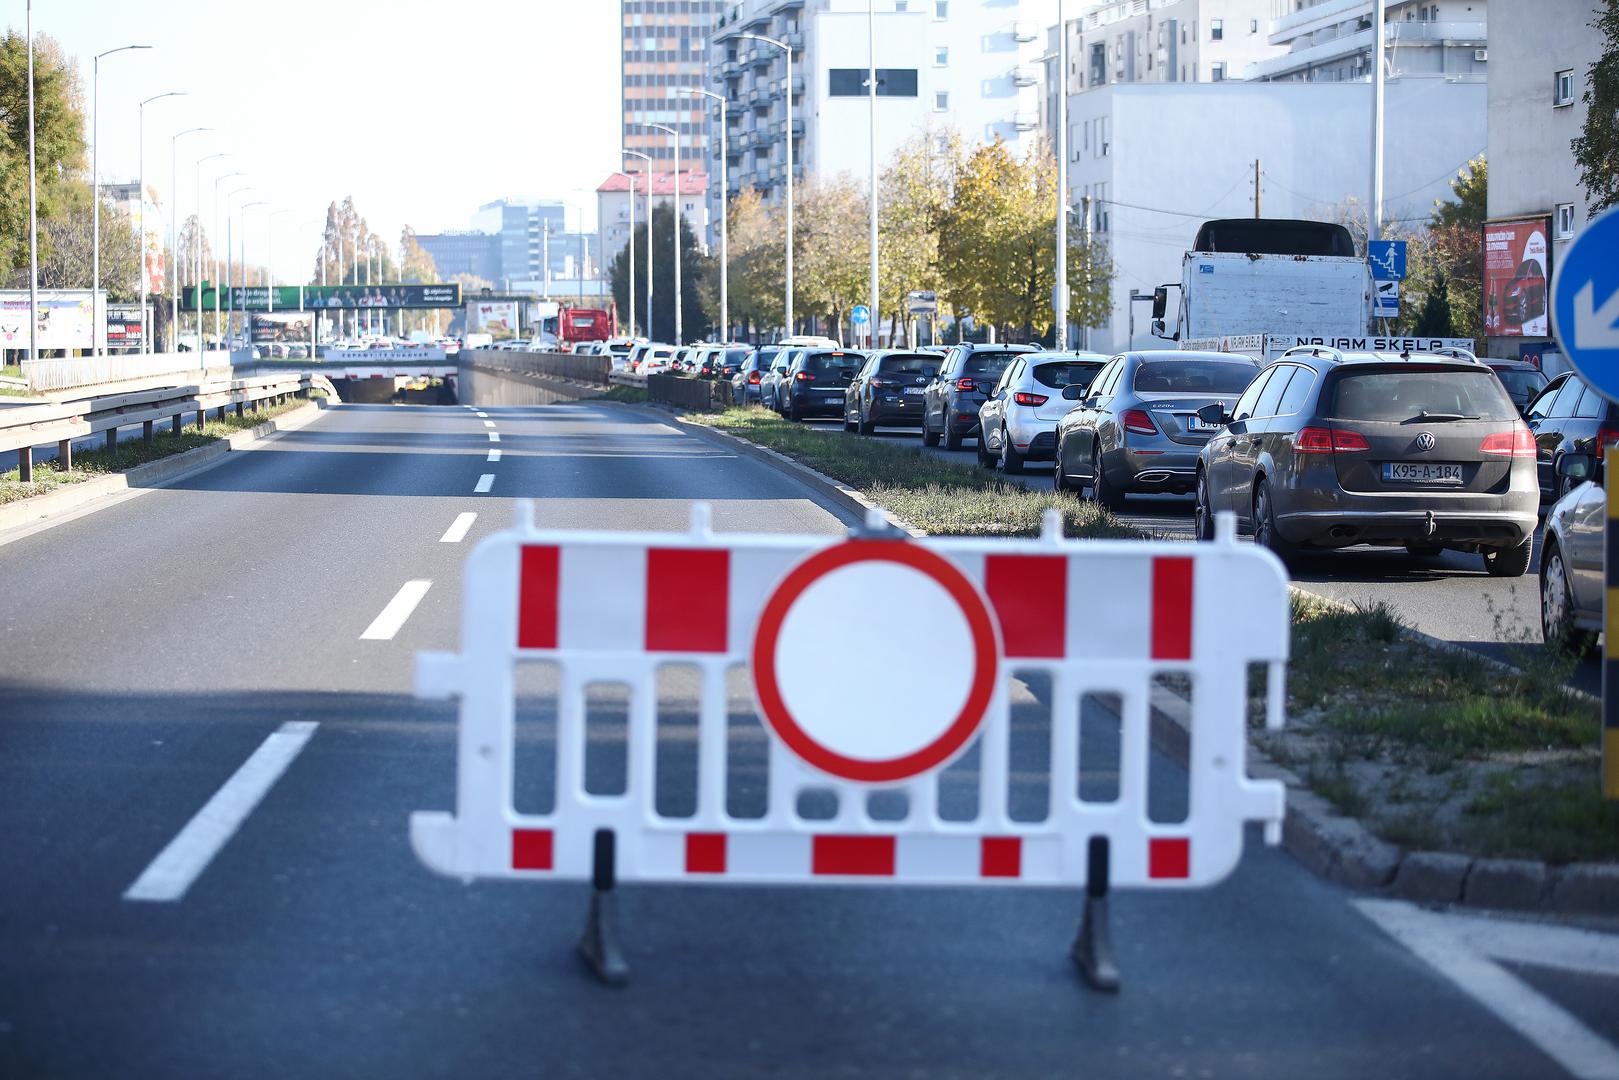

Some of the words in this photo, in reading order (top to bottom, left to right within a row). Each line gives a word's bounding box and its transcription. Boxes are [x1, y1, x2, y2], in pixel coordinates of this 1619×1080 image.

[1297, 337, 1366, 350] NAJAM
[1374, 338, 1443, 351] SKELA
[1392, 464, 1460, 479] K95-A-184
